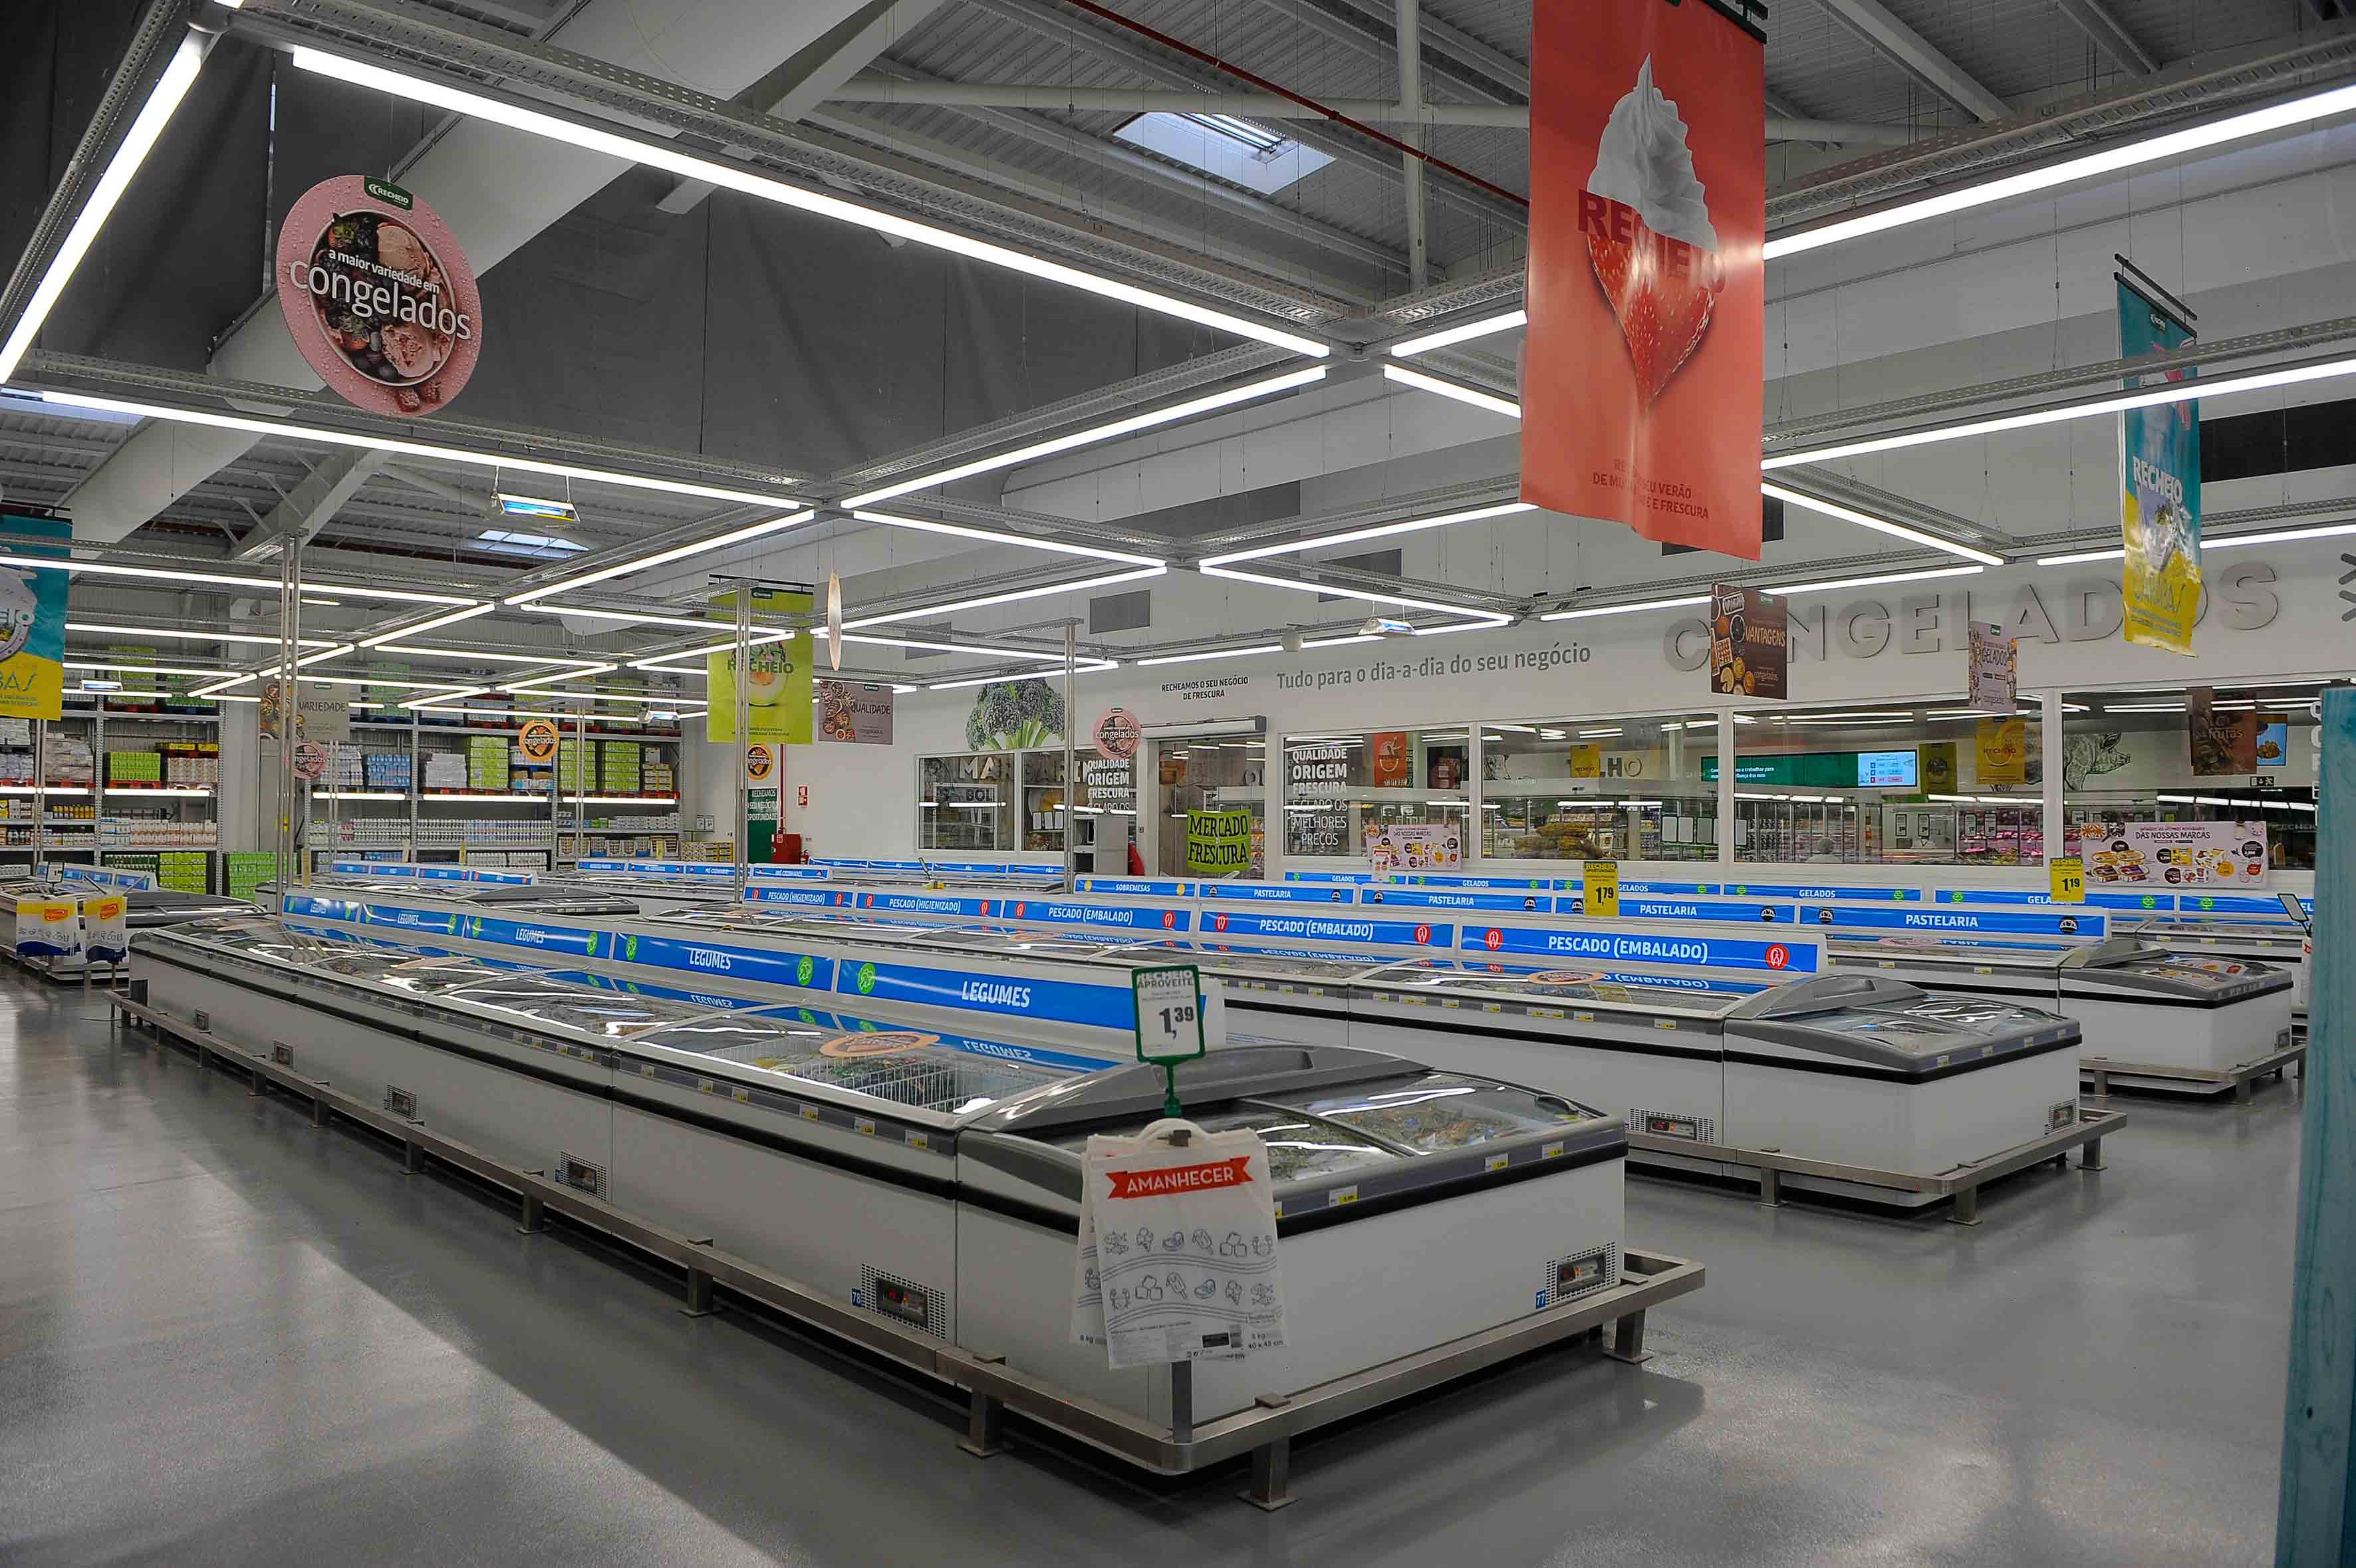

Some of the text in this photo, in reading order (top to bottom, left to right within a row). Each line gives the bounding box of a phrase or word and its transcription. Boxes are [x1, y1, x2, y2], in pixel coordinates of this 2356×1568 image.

[329, 249, 440, 295] a maior variedade em
[289, 260, 471, 340] congelados
[1593, 472, 1607, 486] DE
[2133, 456, 2182, 502] RECHEIO
[1660, 481, 1691, 500] VERÃO
[1652, 499, 1658, 509] E
[1660, 498, 1708, 519] FRESCURA
[1664, 561, 2278, 671] CNGELADS
[1745, 625, 1785, 647] VANTAGENS
[1277, 642, 1591, 690] Tudo para o dia-a-dia do seu negócio
[1161, 681, 1199, 692] RECHEAMOS
[1206, 680, 1218, 688] SEU
[1220, 674, 1248, 686] NEGÓCIO
[1192, 690, 1225, 699] FRESCURA
[299, 702, 346, 712] VARIEDADE
[851, 702, 890, 715] QUALIDADE
[521, 736, 557, 746] congelados
[1095, 729, 1139, 740] congelados
[1292, 748, 1347, 762] QUALIDADE
[1088, 759, 1130, 769] QUALIDADE
[1292, 763, 1347, 779] ORIGEM
[1088, 772, 1130, 785] ORIGEM
[1088, 787, 1130, 799] FRESCURA
[1292, 781, 1347, 794] FRESCURA
[1334, 799, 1347, 811] OS
[1188, 815, 1248, 836] MERCADO
[1293, 816, 1347, 829] MELHORES
[1301, 833, 1339, 848] PREÇOS
[1188, 841, 1249, 865] FRESCURA
[1115, 883, 1150, 892] SOBREMESAS
[2061, 878, 2080, 894] 1,19
[768, 891, 825, 904] PESCADO (HIGIENIZADO)
[1254, 889, 1291, 899] PASTELARIA
[1428, 895, 1474, 906] PASTELARIA
[1596, 886, 1614, 907] 1,79
[1799, 889, 1836, 898] GELADOS
[888, 898, 961, 914] PESCADO (HIGIENIZADO)
[1640, 904, 1697, 916] PASTELARIA
[398, 912, 420, 926] LEGUMES
[1048, 906, 1132, 924] PESCADO (EMBALADO)
[1905, 914, 1979, 928] PASTELARIA
[515, 928, 545, 944] LEGUMES
[1259, 918, 1374, 941] PESCADO (EMBALADO)
[1548, 935, 1708, 964] PESCADO (EMBALADO)
[689, 949, 731, 970] LEGUMES
[1138, 978, 1194, 989] APROVEITE
[1159, 1005, 1194, 1040] 1,39
[1126, 1166, 1235, 1194] AMANHECER
[852, 1291, 861, 1305] 78
[1537, 1293, 1545, 1306] 77
